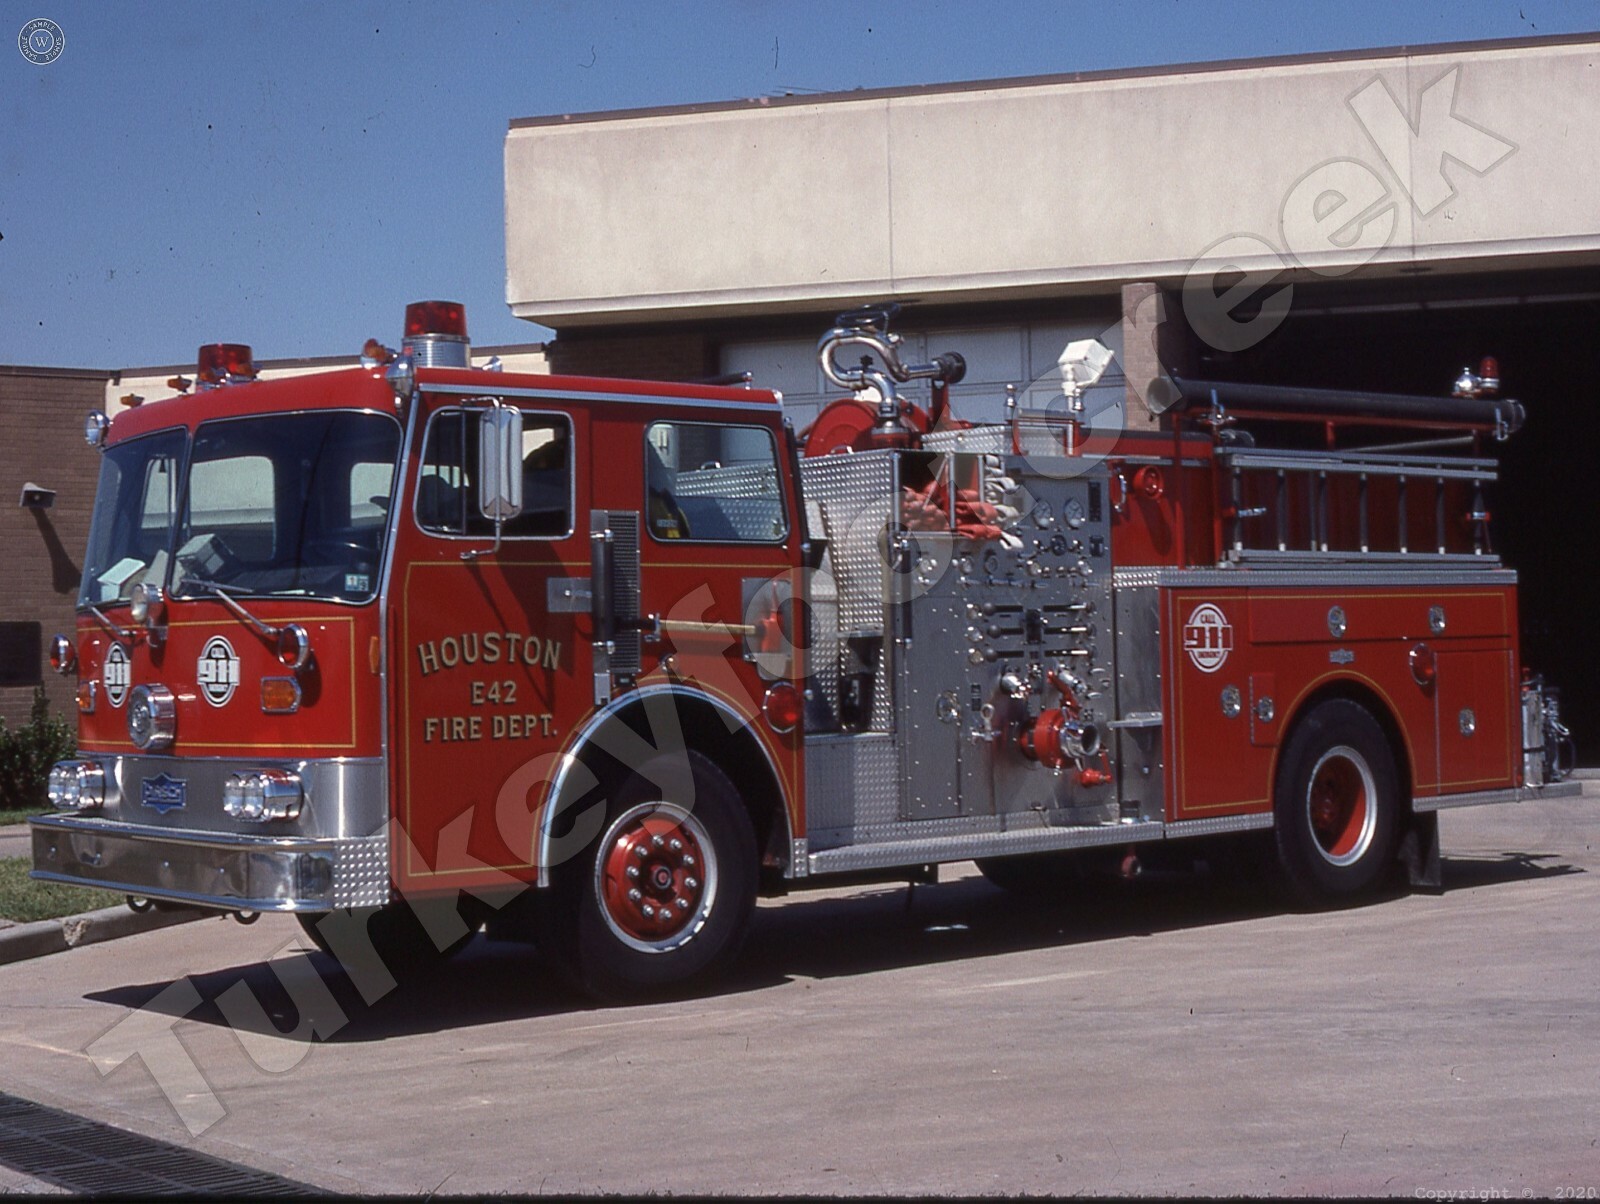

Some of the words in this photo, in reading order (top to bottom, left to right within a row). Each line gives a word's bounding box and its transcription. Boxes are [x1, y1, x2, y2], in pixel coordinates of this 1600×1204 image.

[1184, 625, 1233, 650] 911
[417, 631, 562, 675] HOUSTON
[197, 657, 240, 685] 911
[471, 680, 518, 705] E42
[425, 716, 483, 742] FIRE
[492, 713, 558, 739] DEPT.
